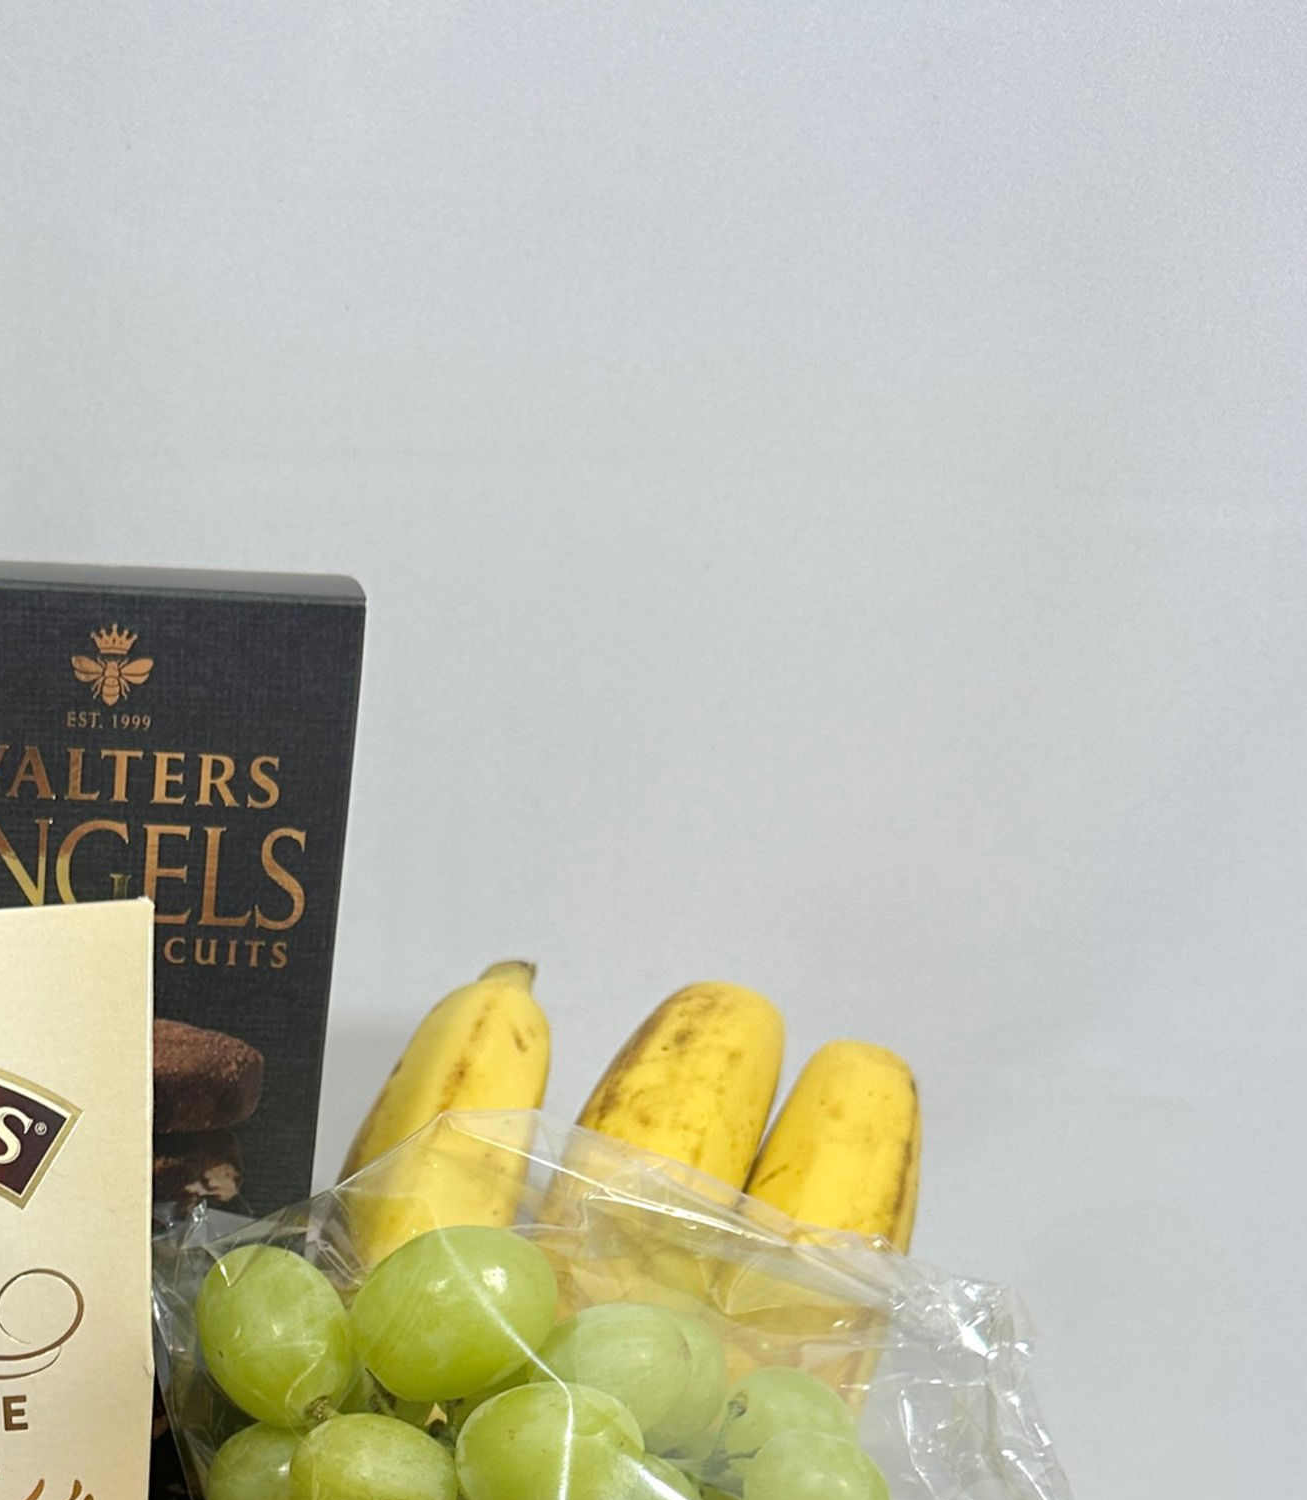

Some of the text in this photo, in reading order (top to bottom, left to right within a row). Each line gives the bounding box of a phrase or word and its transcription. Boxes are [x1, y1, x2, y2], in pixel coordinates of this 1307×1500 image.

[66, 711, 152, 732] EST. 1999
[163, 937, 289, 969] CUITS
